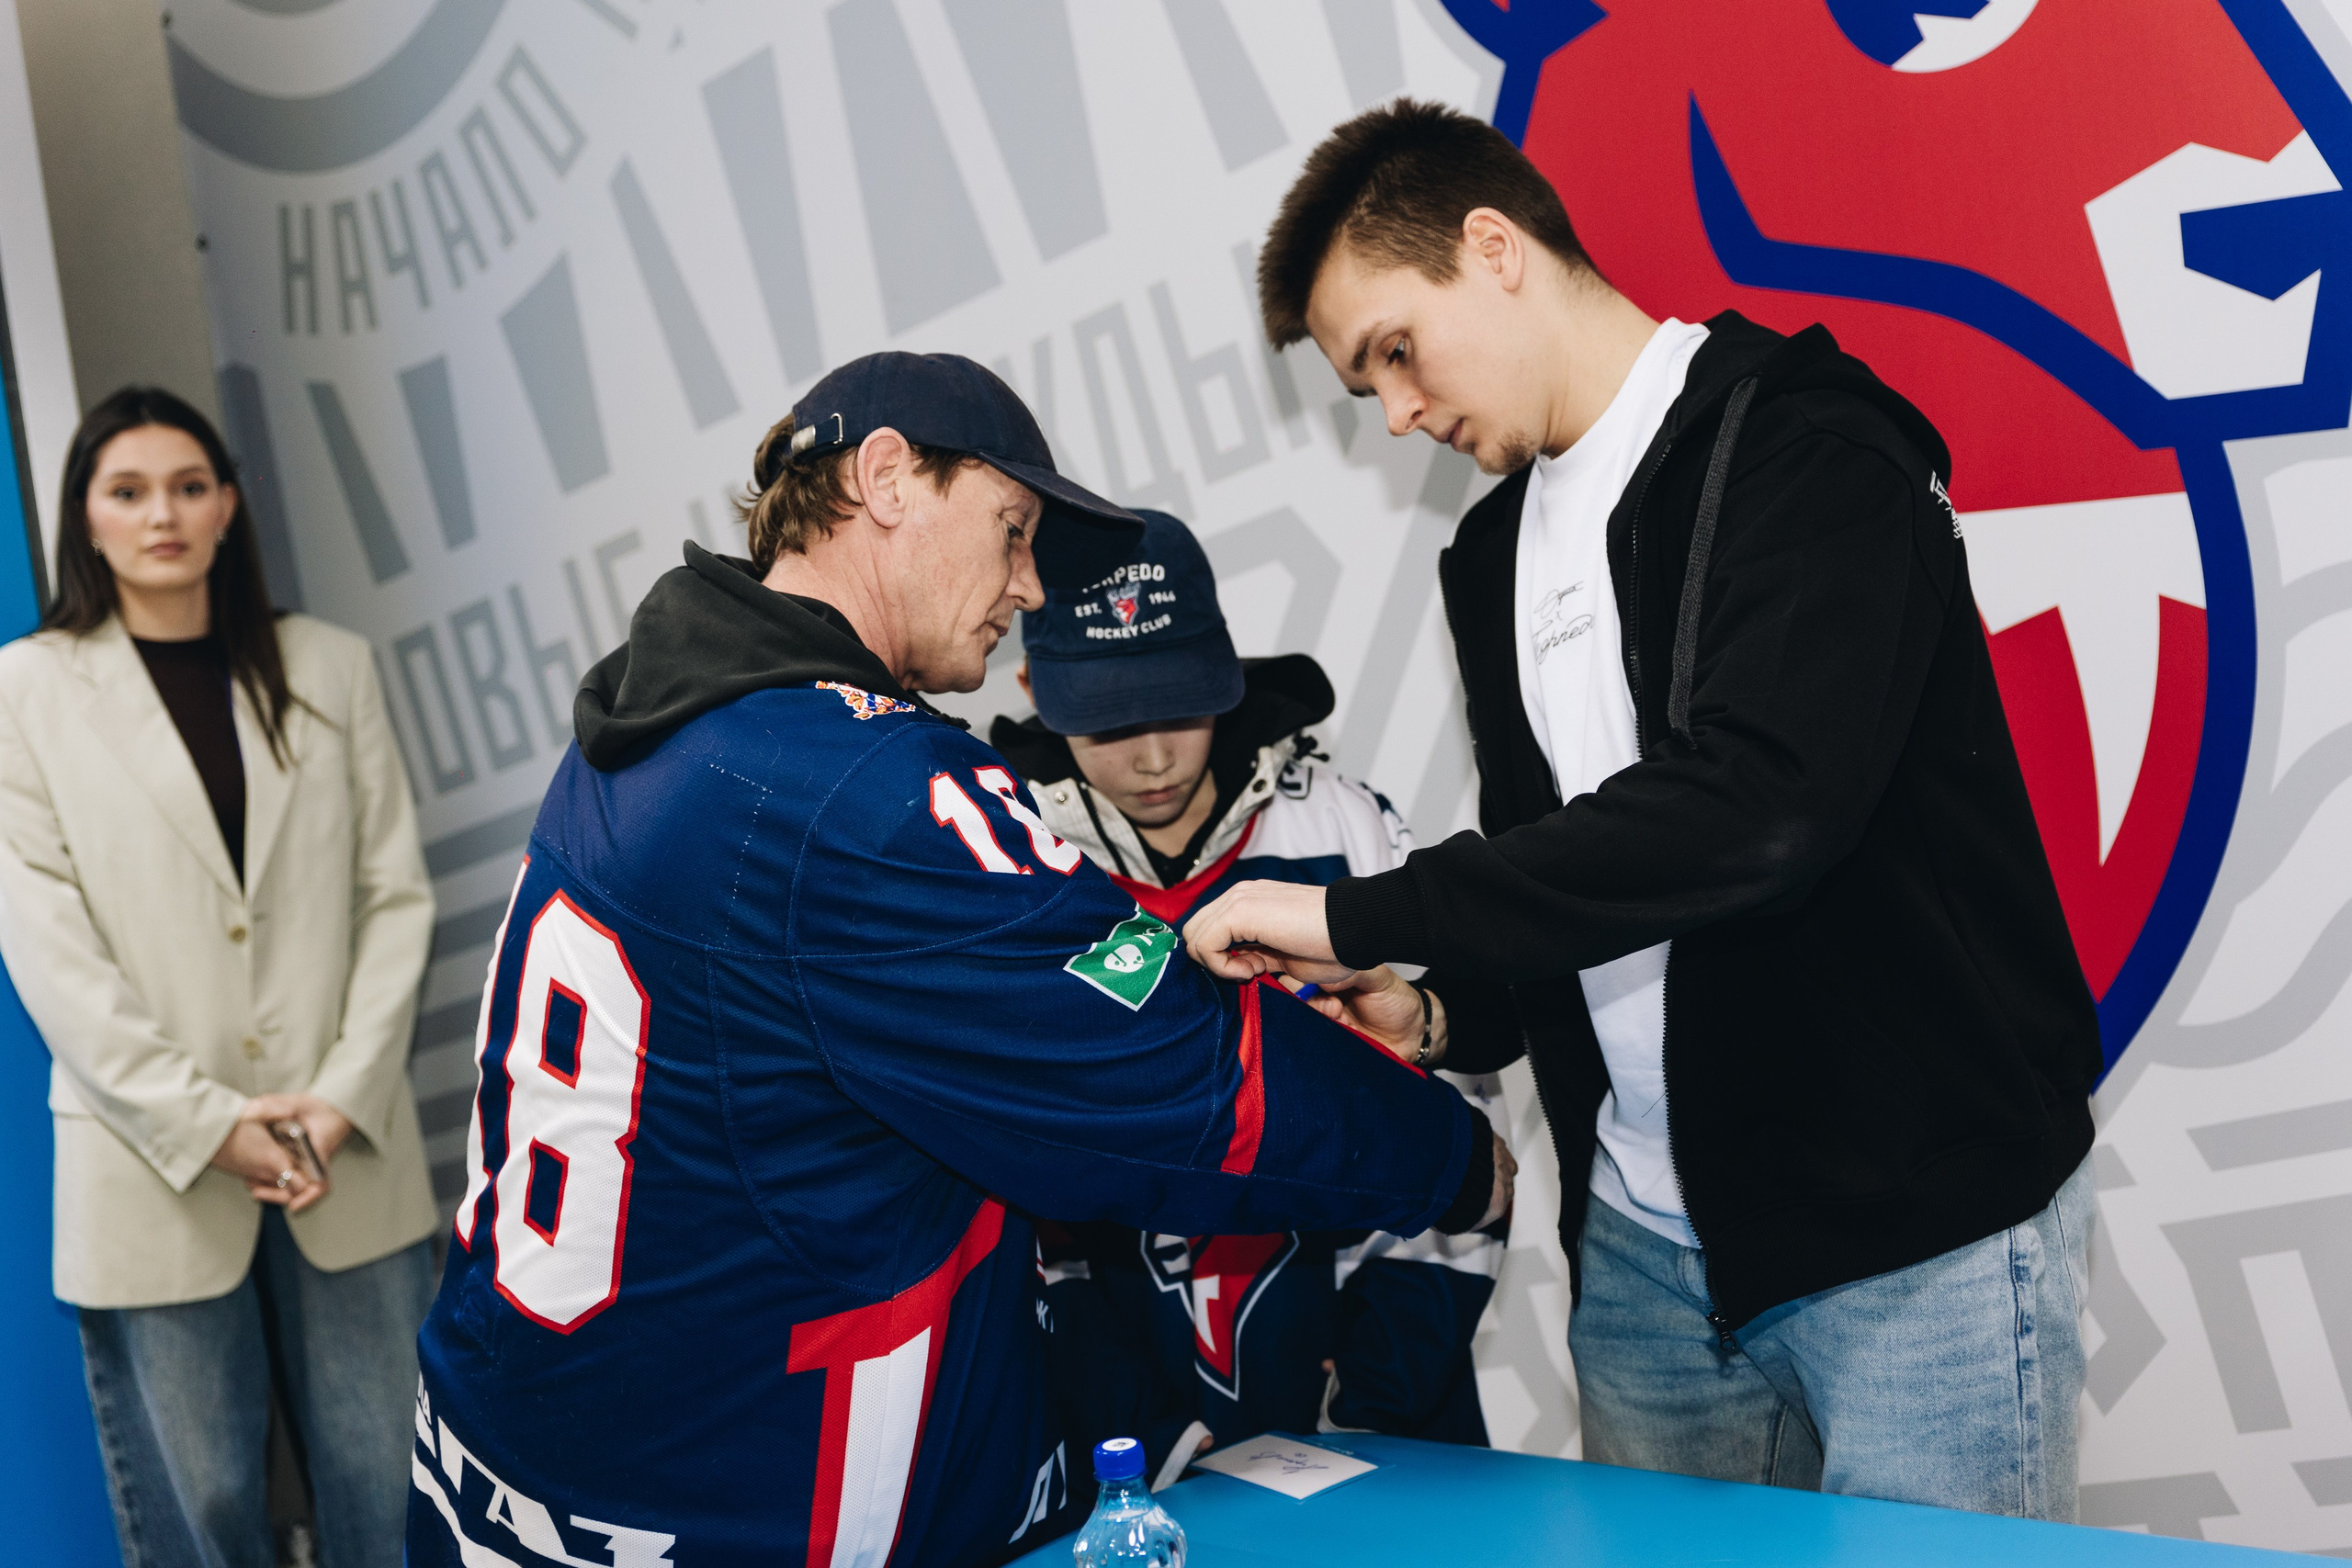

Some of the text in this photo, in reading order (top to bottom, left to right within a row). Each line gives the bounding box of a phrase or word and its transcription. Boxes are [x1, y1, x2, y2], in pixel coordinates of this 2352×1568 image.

[277, 42, 588, 337] НАЧАЛО
[1082, 562, 1166, 594] PEDO
[1074, 602, 1102, 618] EST.
[1086, 613, 1172, 640] HOCKEY CLUB
[929, 764, 1083, 877] 18
